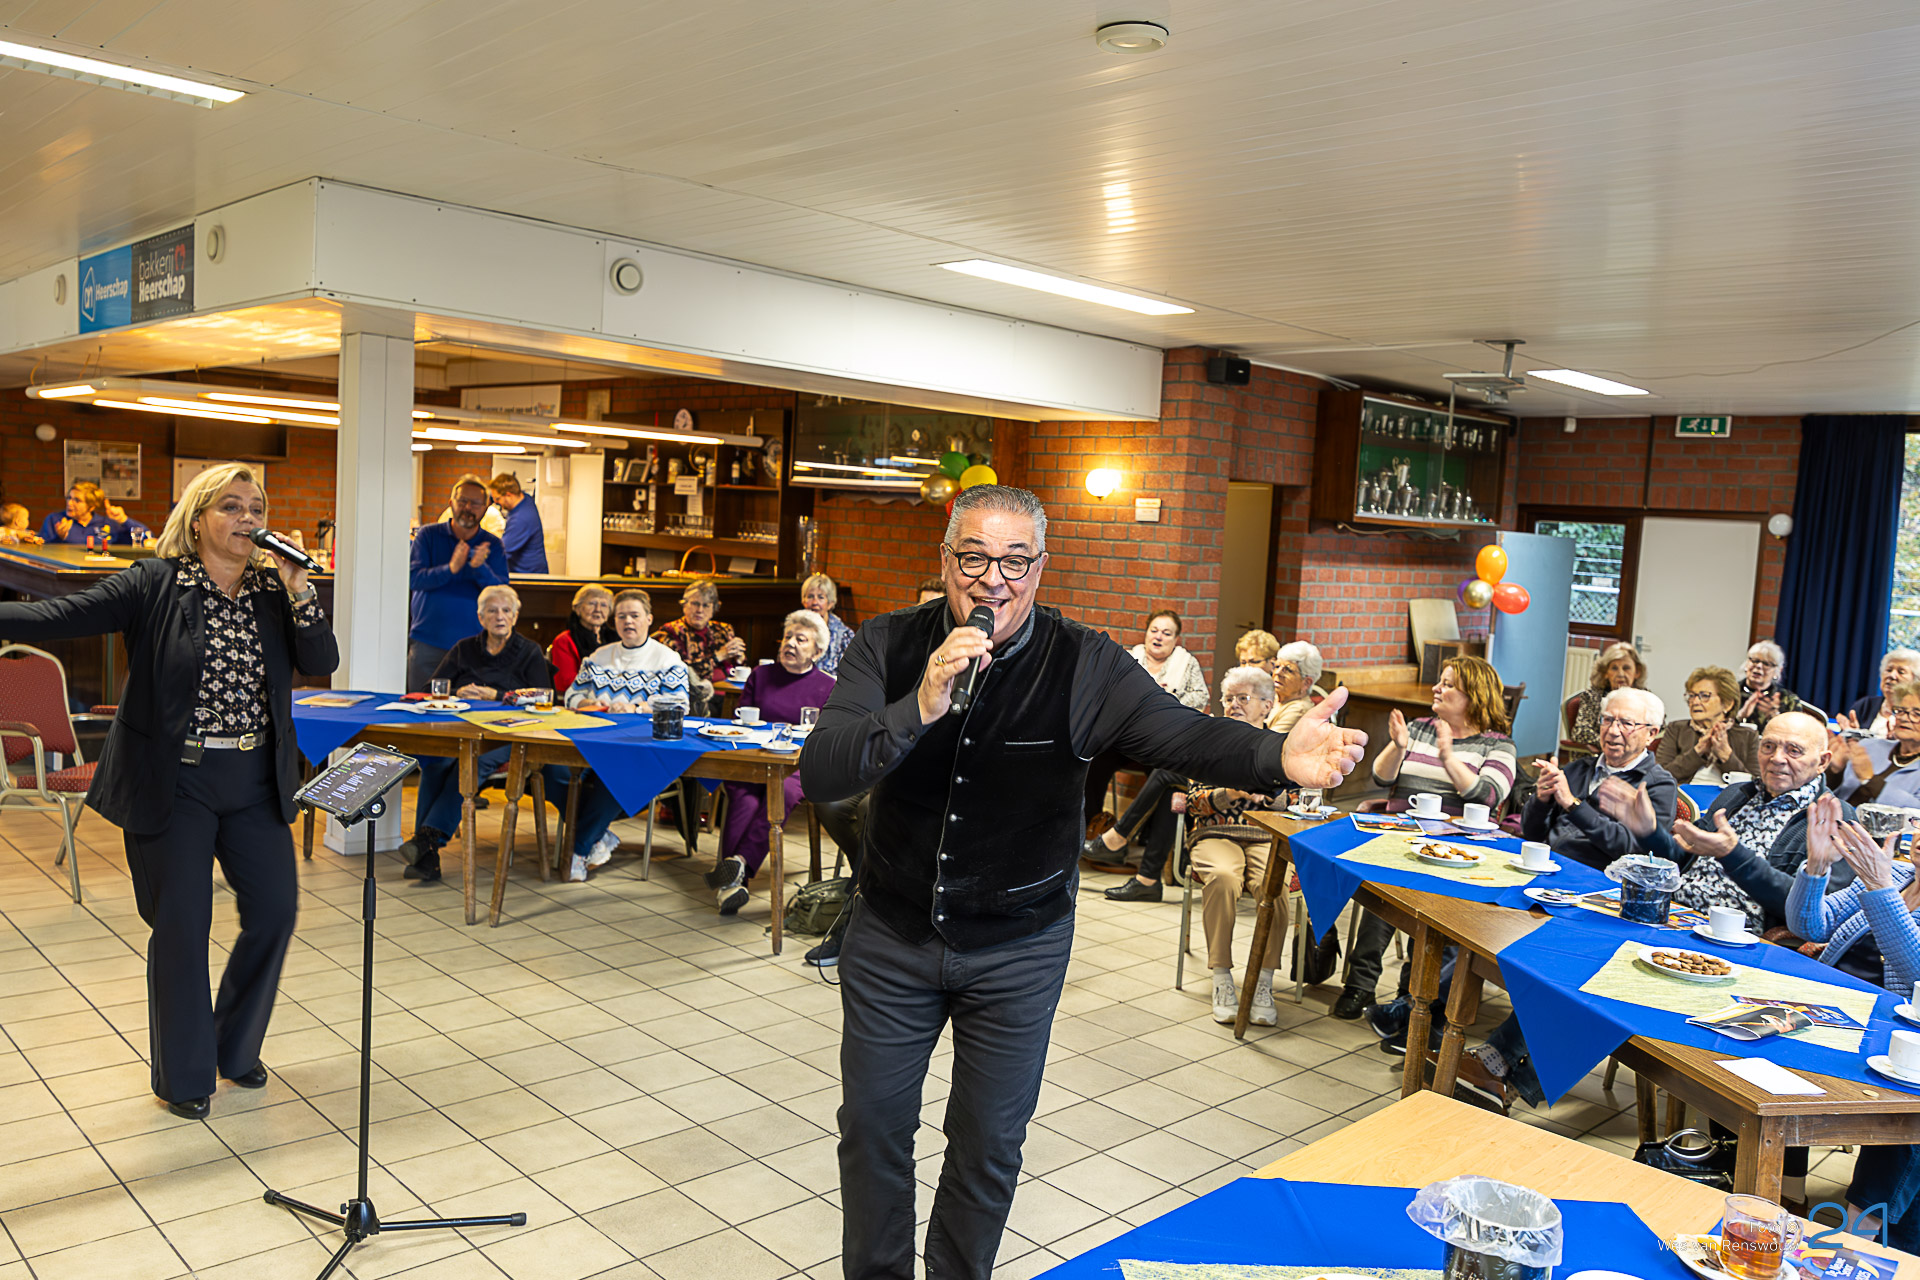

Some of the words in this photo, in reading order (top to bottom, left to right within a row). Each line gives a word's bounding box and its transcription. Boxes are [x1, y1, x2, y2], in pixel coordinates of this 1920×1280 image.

[139, 248, 174, 280] bakkerij
[95, 277, 128, 301] Heerschap
[139, 273, 186, 303] Heerschap
